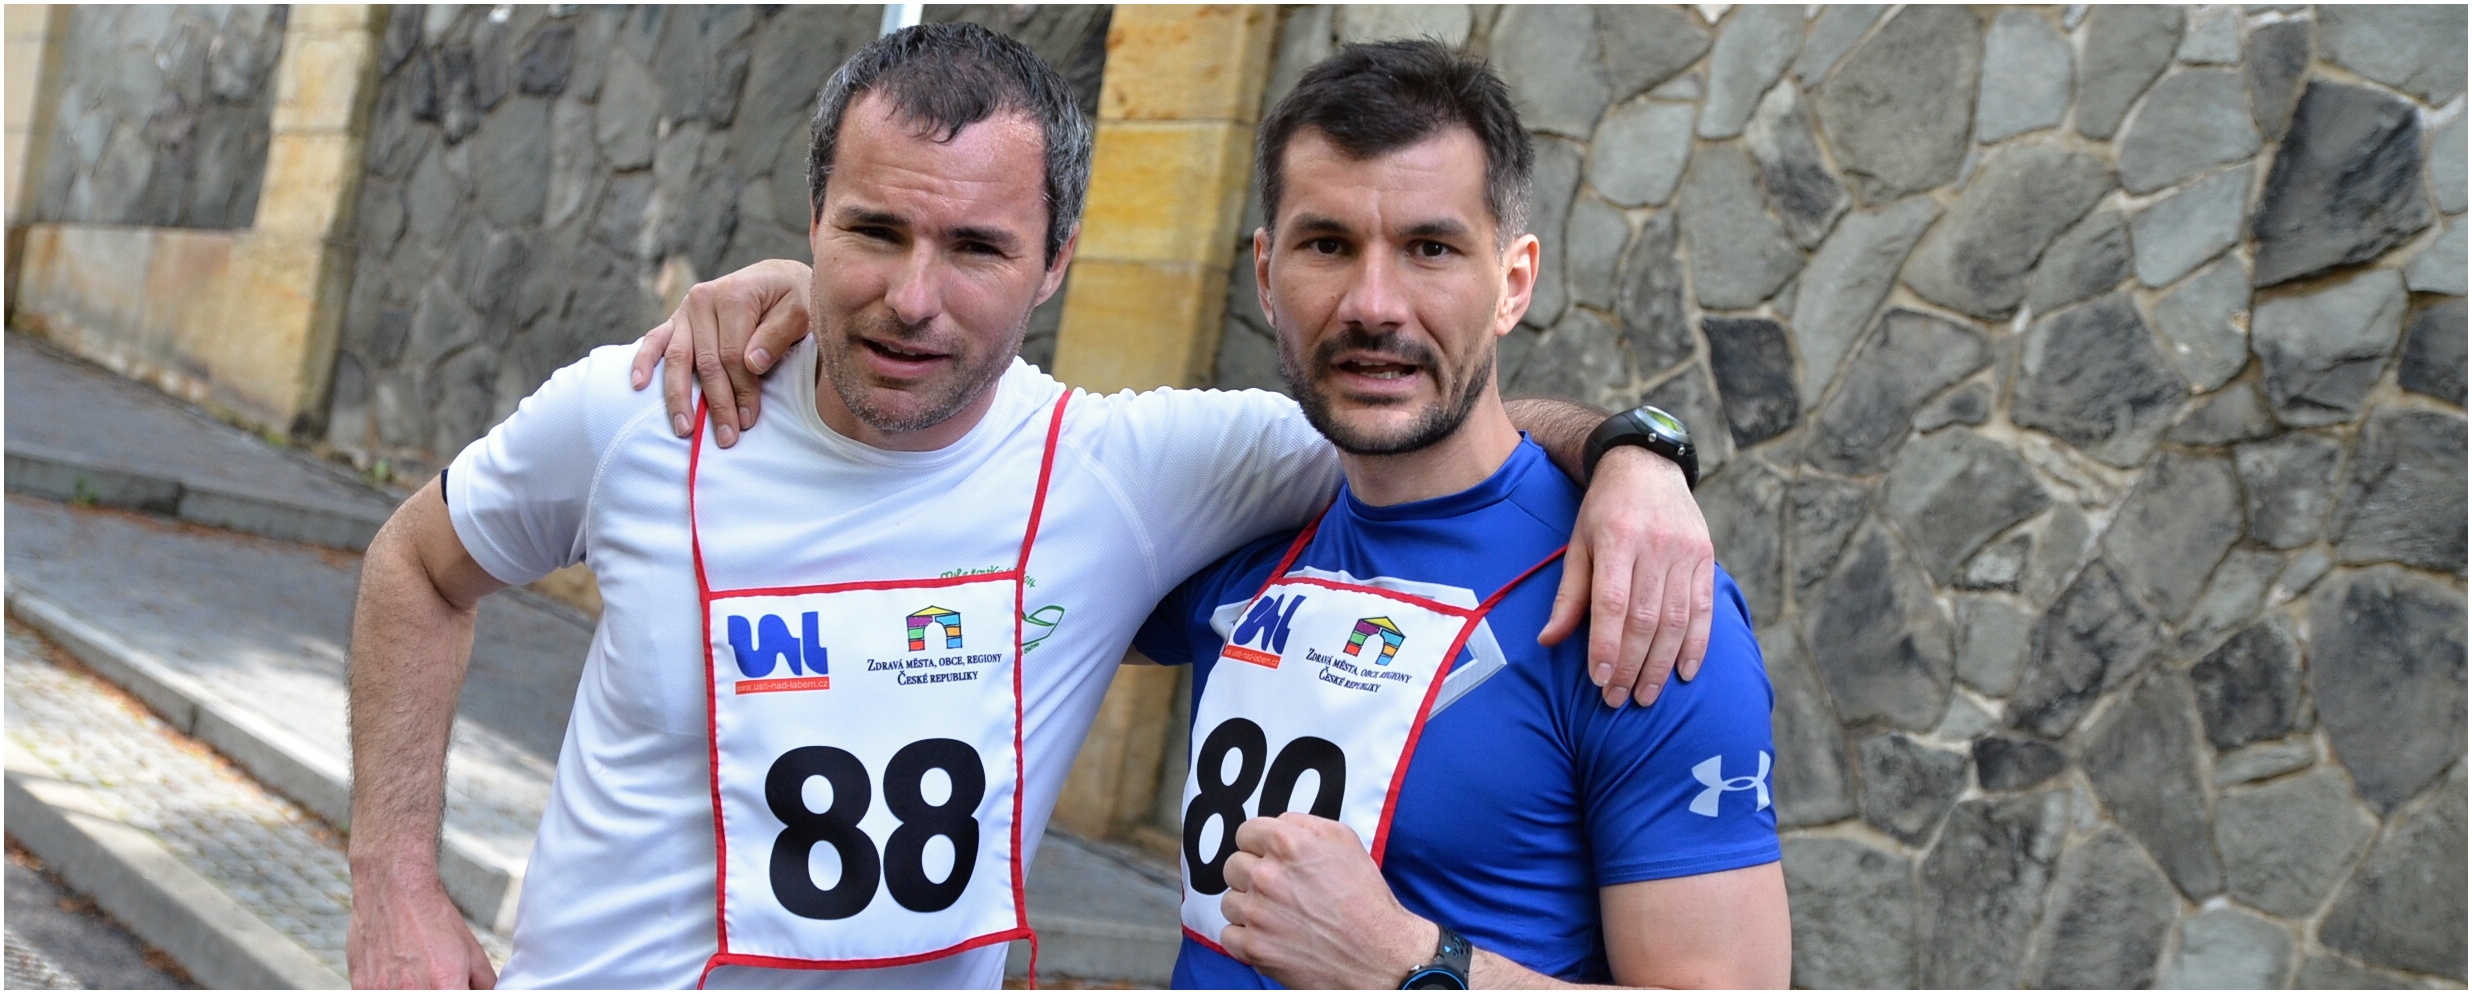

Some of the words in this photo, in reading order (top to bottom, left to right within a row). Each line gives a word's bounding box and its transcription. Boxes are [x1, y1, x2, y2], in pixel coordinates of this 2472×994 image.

[867, 658, 904, 671] ZDRAVÁ
[905, 657, 937, 669] MĚSTA,
[939, 656, 965, 667] OBCE,
[967, 653, 1002, 664] REGIONY
[1332, 659, 1358, 676] MĚSTA,
[897, 670, 928, 685] ČESKÉ
[930, 671, 978, 683] REPUBLIKY
[765, 738, 986, 920] 88
